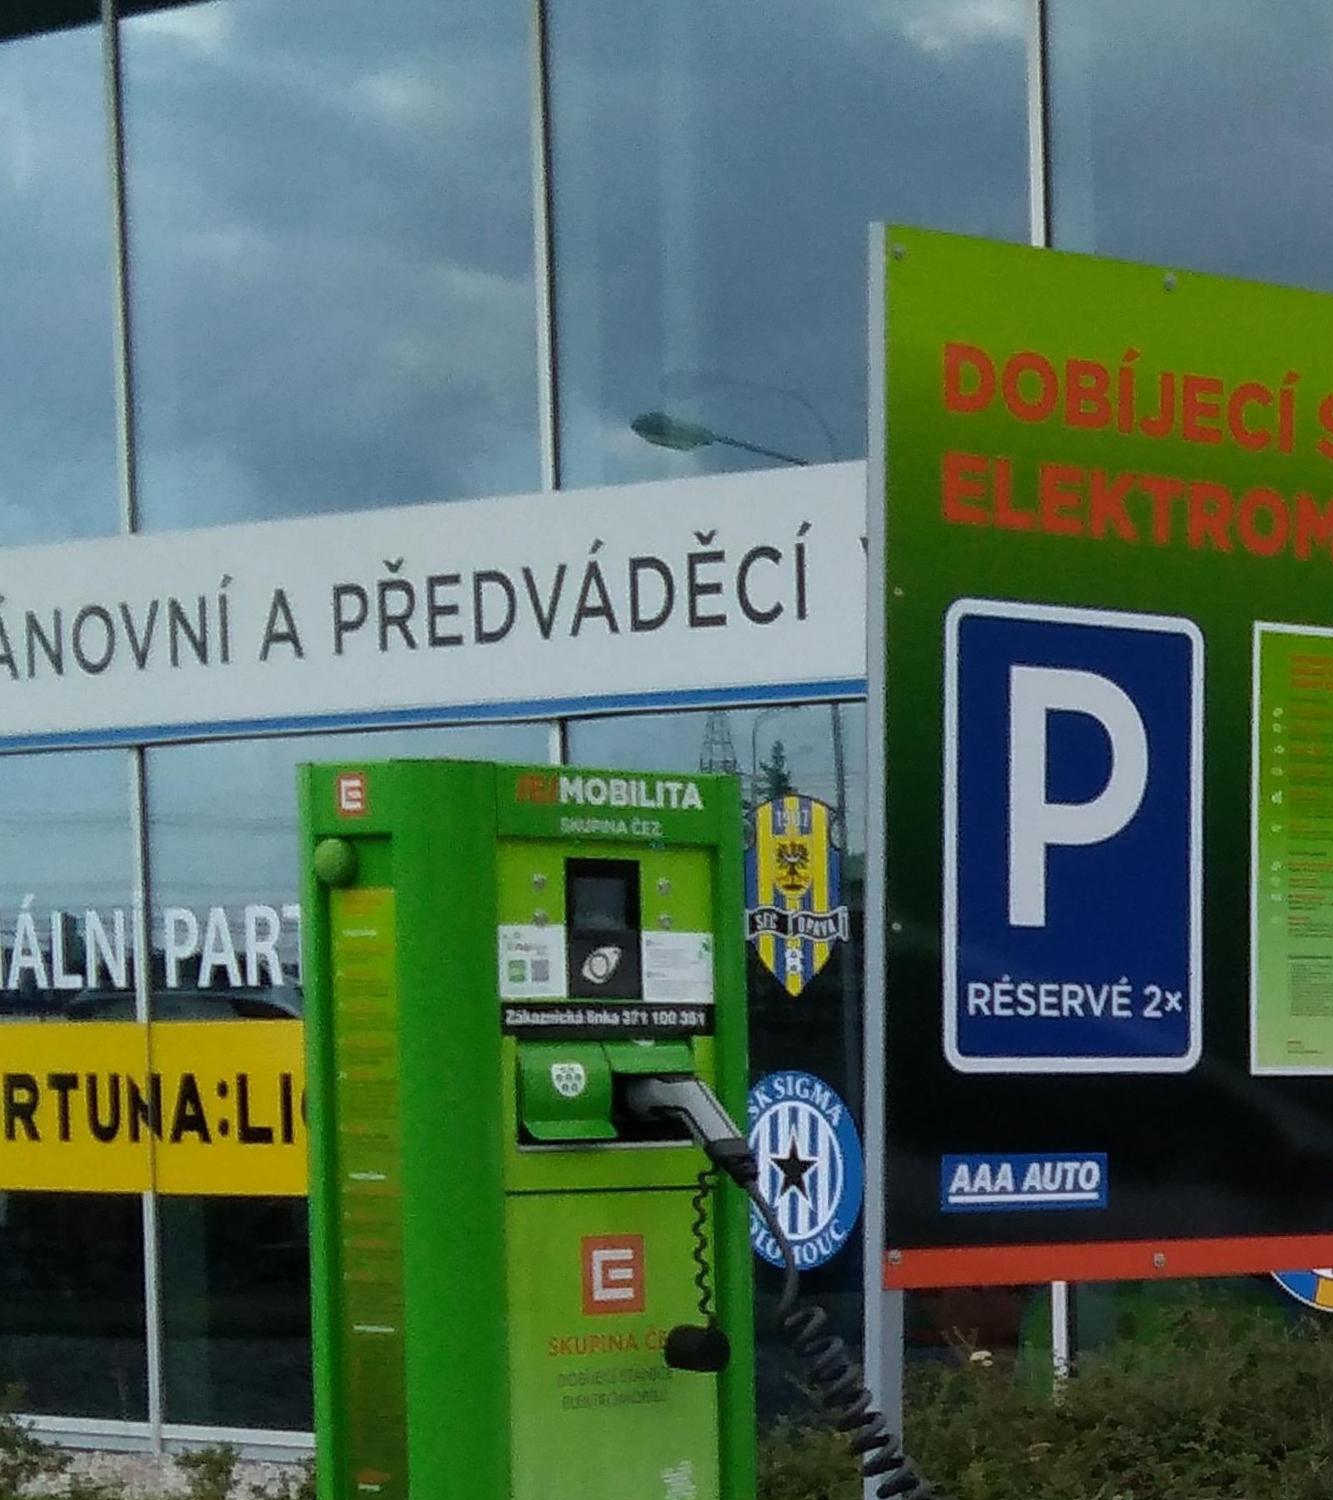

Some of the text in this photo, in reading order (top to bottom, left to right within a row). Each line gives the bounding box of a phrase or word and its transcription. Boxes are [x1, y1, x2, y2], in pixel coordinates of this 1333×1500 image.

[943, 341, 1300, 454] DOBÍJECÍ
[260, 588, 304, 662] A
[332, 522, 812, 656] PŘEDVÁDĚCÍ
[1009, 664, 1149, 928] P
[967, 974, 1132, 1019] RÉSERVÉ
[3, 1072, 308, 1145] RTUNA:LI
[772, 1075, 844, 1128] SIGMA
[949, 1160, 1101, 1194] AAA AUTO
[547, 1332, 638, 1357] SKUPINA
